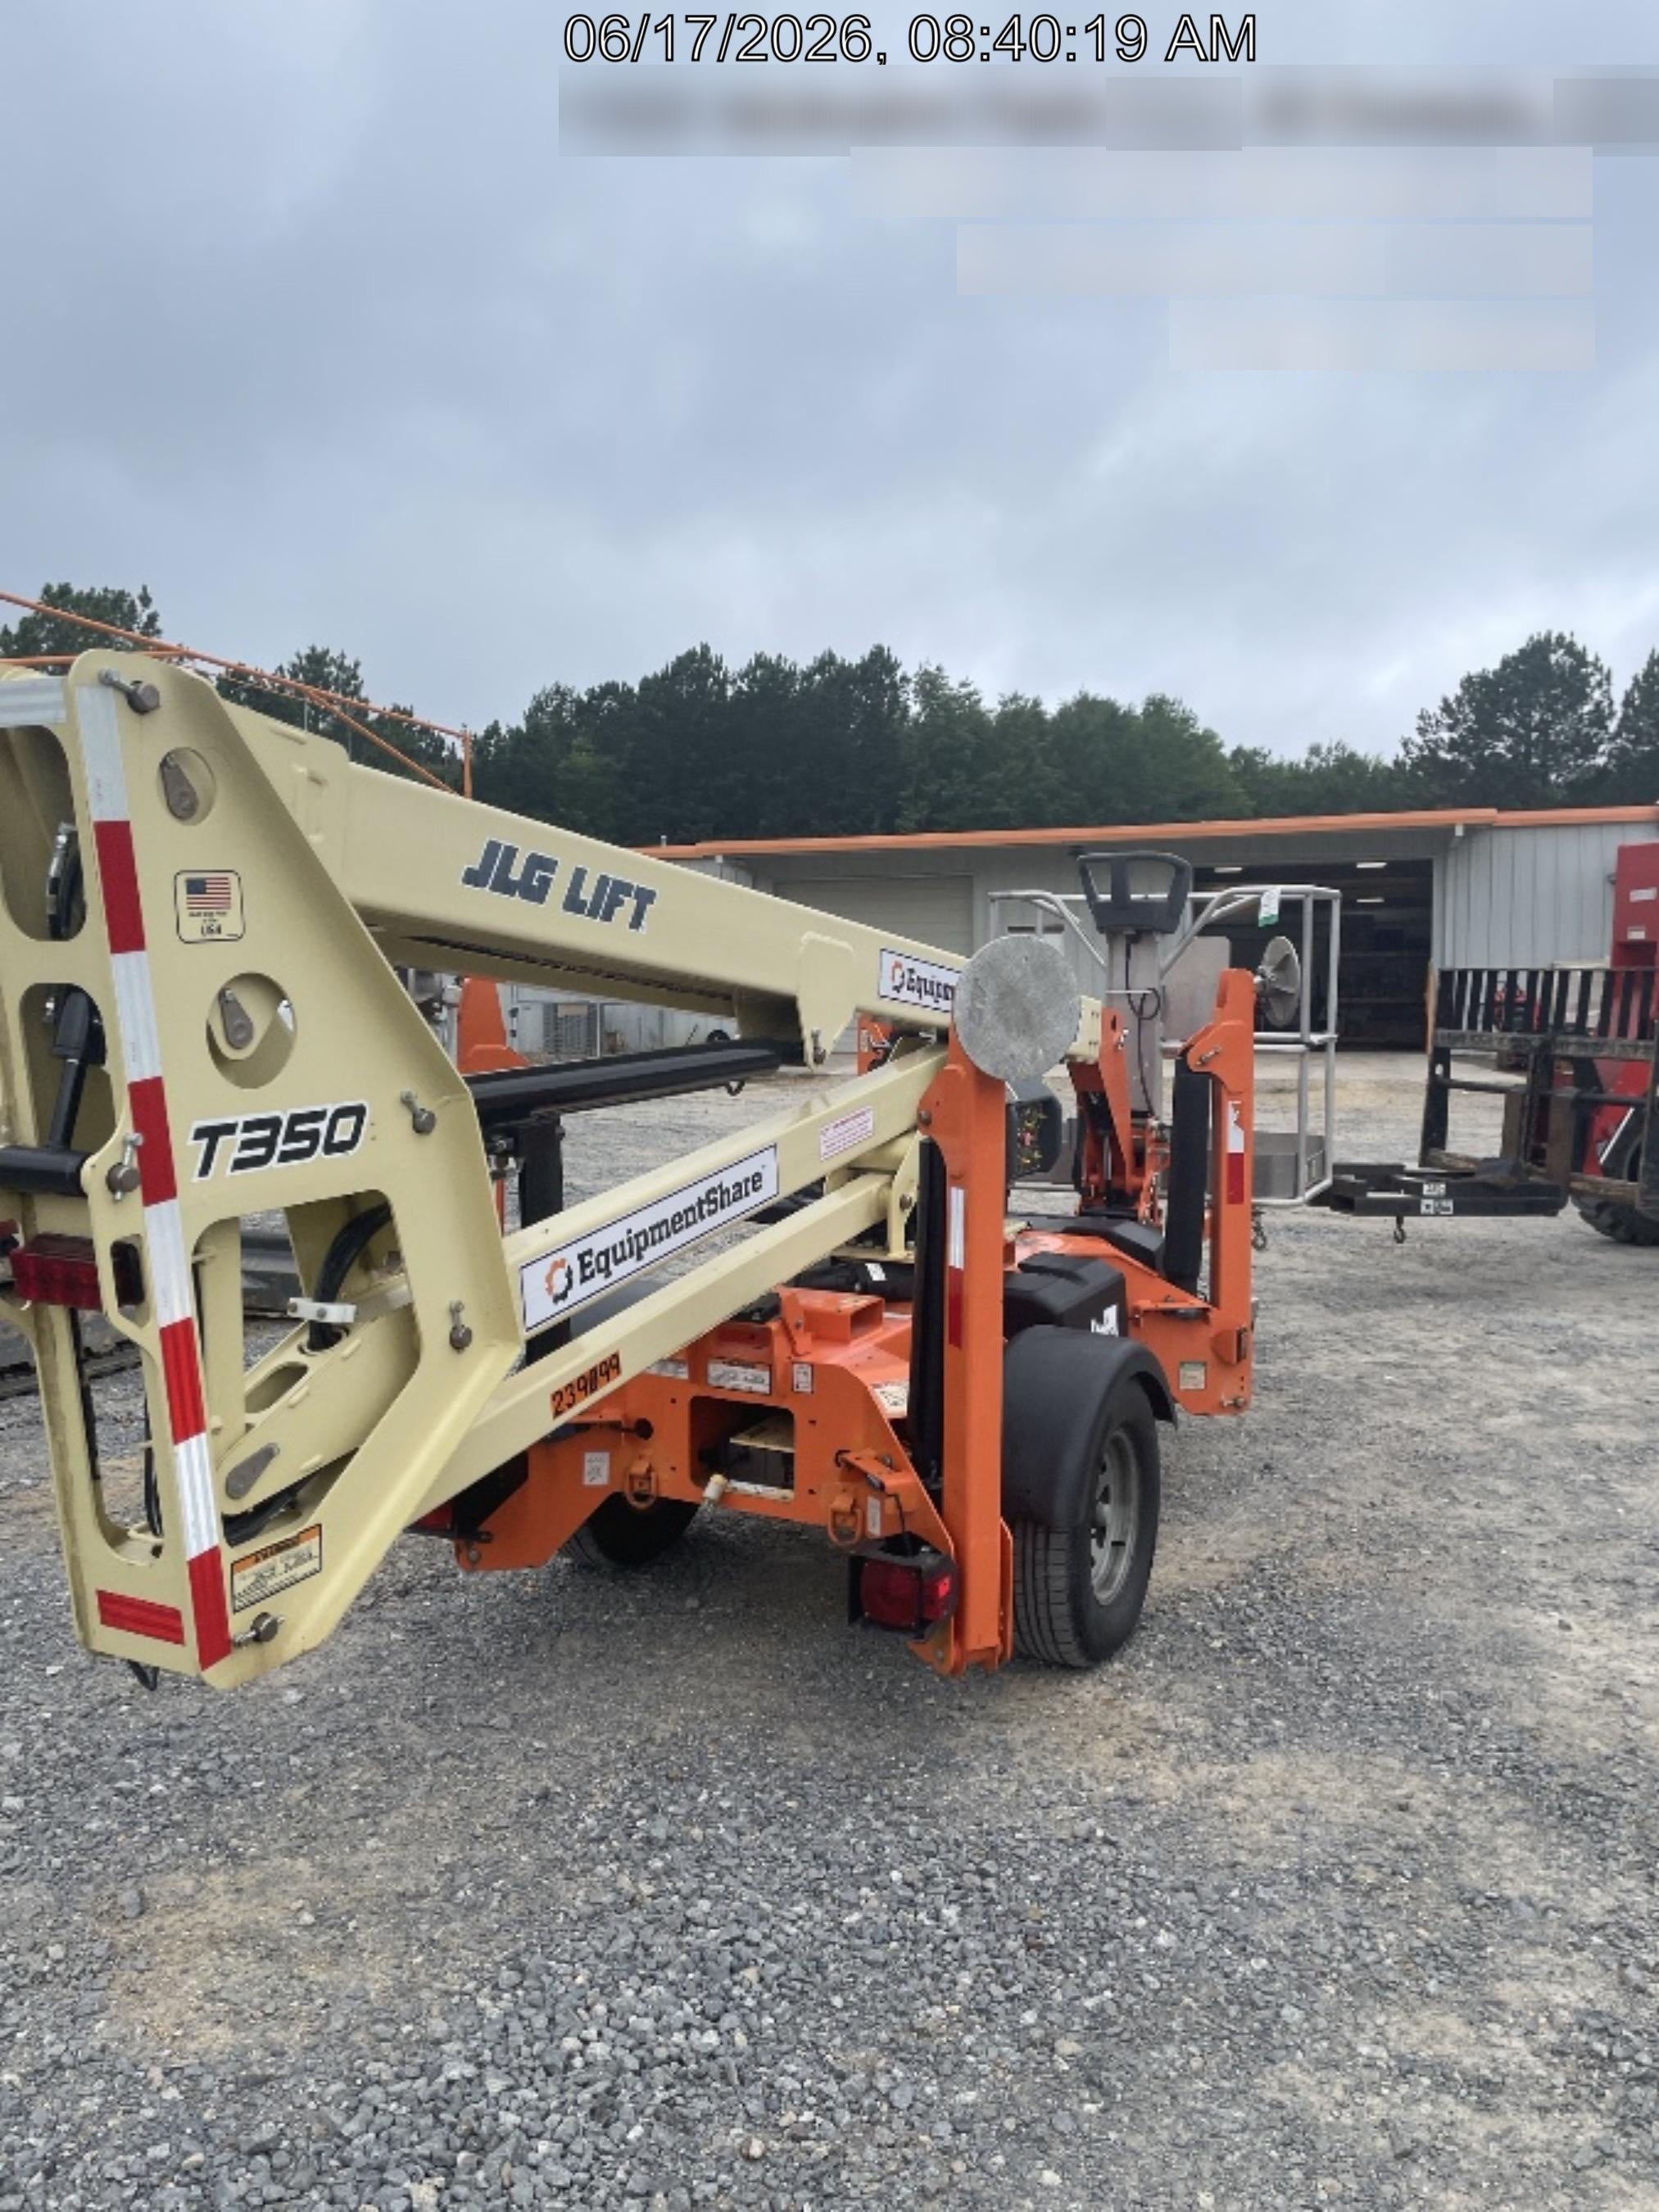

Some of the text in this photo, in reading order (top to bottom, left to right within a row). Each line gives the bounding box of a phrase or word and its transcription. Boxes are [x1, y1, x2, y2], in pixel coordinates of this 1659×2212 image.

[461, 838, 657, 932] JLG LIFT
[190, 1102, 368, 1180] T350
[577, 1170, 764, 1285] EquipmentShare
